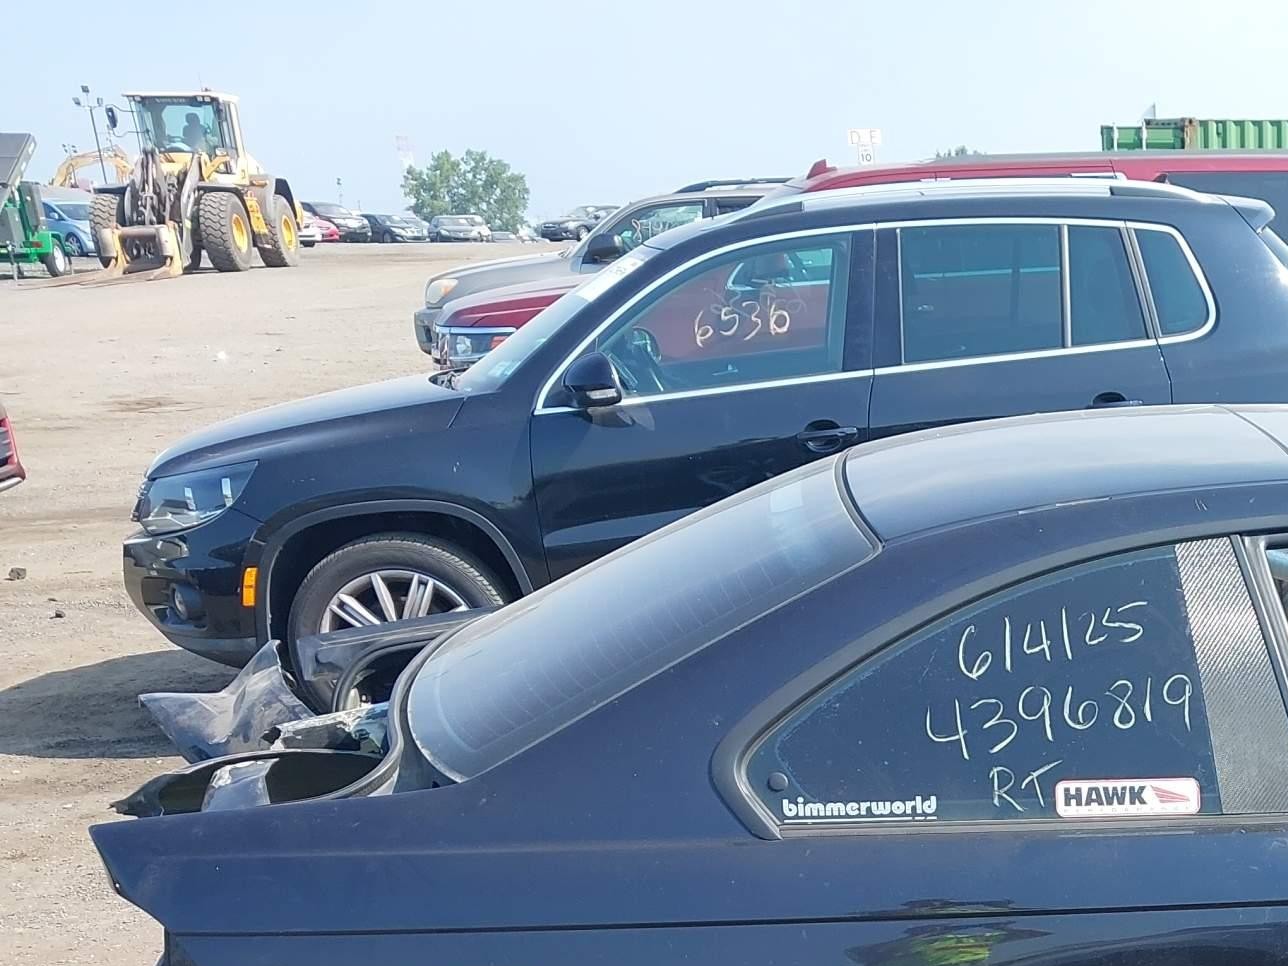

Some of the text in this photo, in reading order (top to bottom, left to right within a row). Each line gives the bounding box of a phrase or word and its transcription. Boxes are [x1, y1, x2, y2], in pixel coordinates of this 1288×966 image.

[860, 152, 873, 162] 10
[694, 299, 790, 348] 6536
[925, 674, 1193, 760] 4396819
[988, 760, 1064, 812] RT
[1063, 785, 1148, 807] HAWK
[781, 794, 938, 817] bimmerworld
